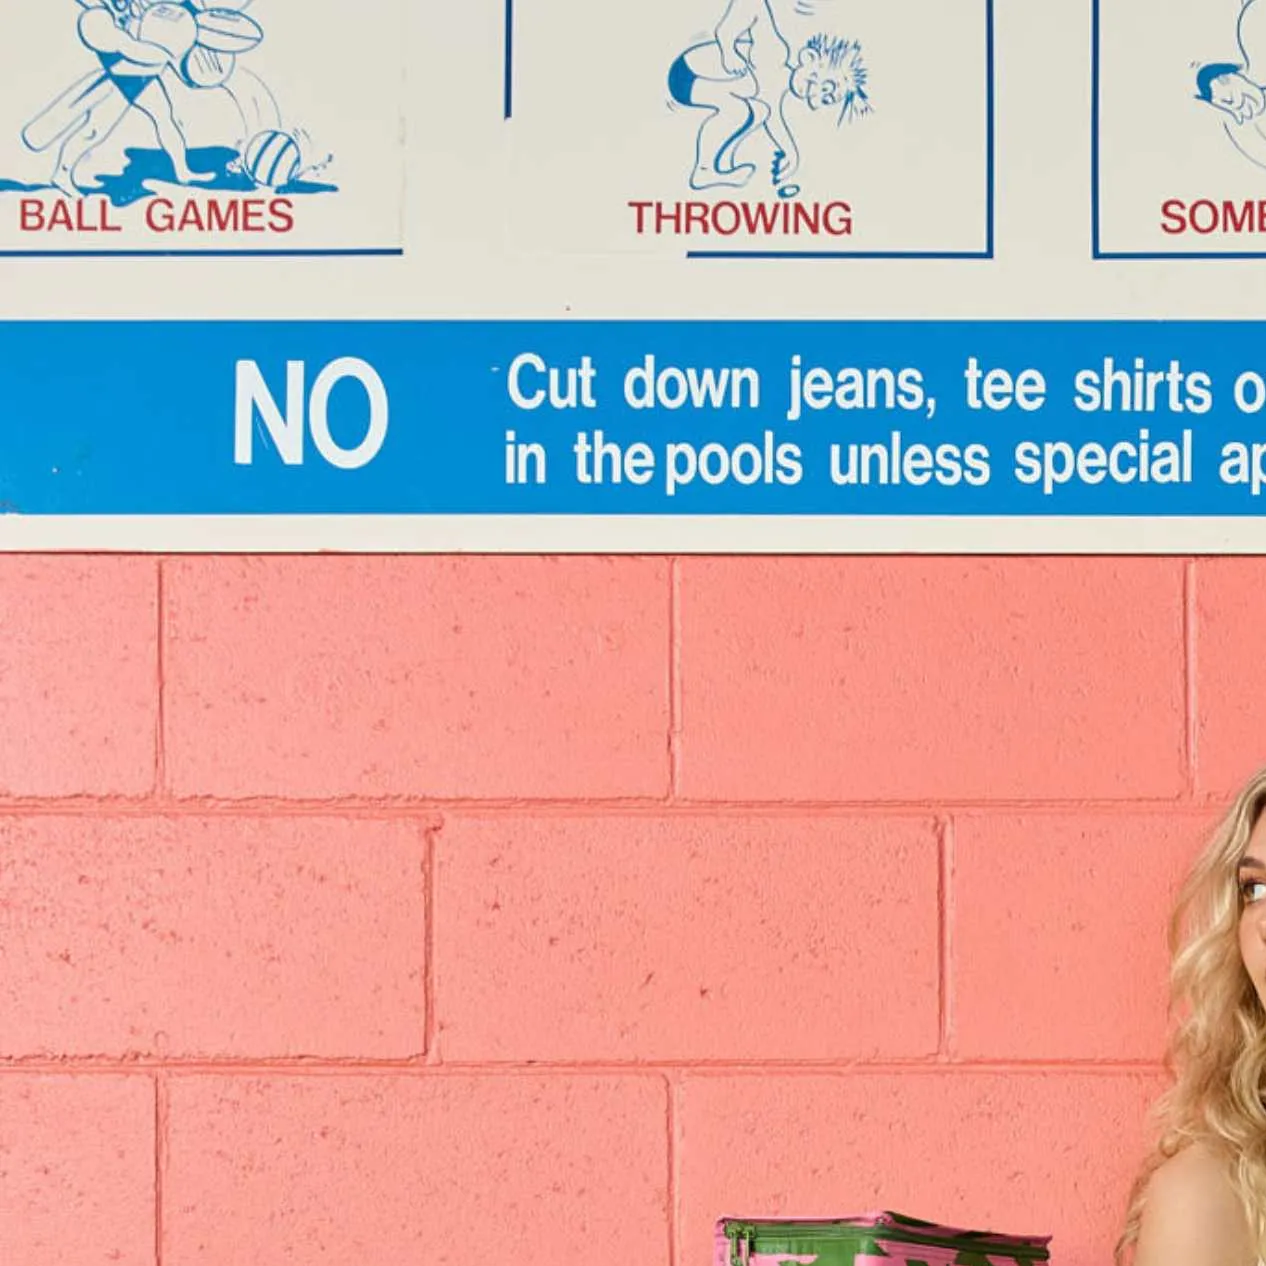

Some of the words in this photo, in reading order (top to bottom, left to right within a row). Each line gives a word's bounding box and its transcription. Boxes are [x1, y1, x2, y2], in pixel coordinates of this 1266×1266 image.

[19, 198, 122, 231] BALL
[145, 197, 294, 233] GAMES
[627, 200, 853, 236] THROWING
[234, 356, 389, 469] NO
[507, 353, 596, 410] Cut
[623, 355, 760, 409] down
[788, 355, 936, 420] jeans,
[964, 358, 1046, 411] tee
[1074, 358, 1213, 414] shirts
[505, 431, 546, 484] in
[573, 431, 655, 485] the
[666, 431, 803, 496] pools
[830, 432, 991, 486] unless
[1014, 429, 1192, 495] special
